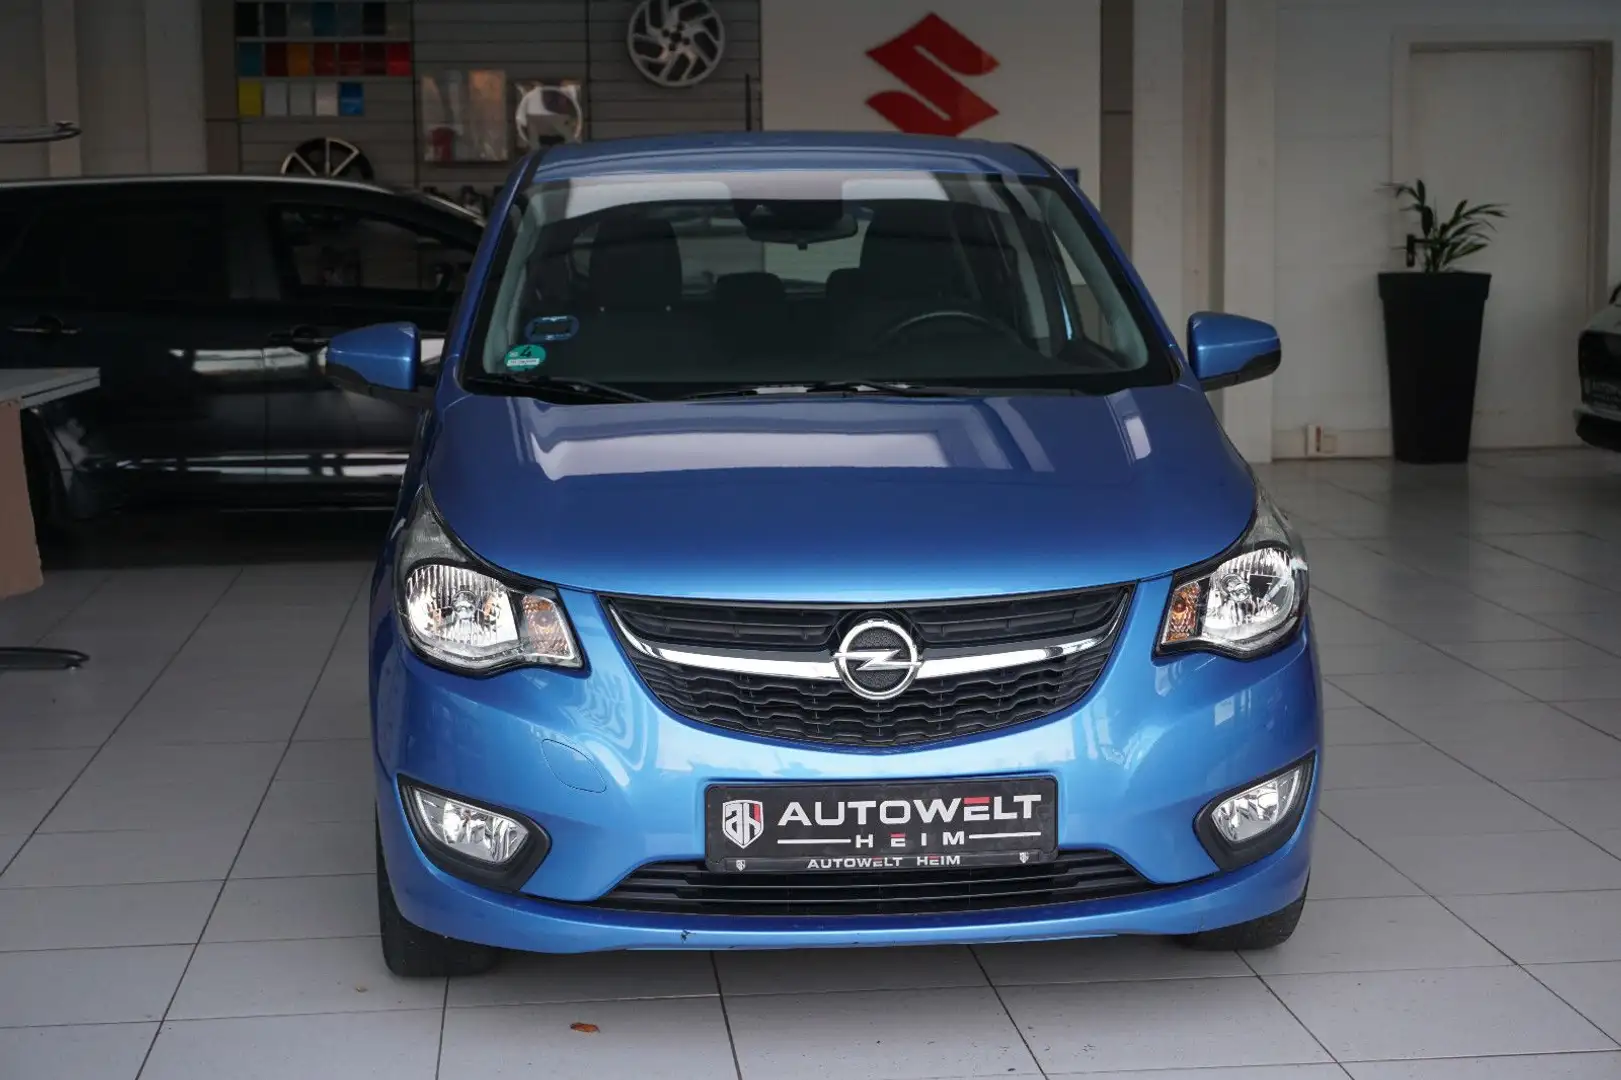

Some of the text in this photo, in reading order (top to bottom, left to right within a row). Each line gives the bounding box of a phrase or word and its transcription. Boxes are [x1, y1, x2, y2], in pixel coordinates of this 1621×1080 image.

[520, 345, 532, 357] 4
[777, 794, 1042, 826] AUTOWELT
[855, 831, 965, 848] HEIM
[807, 855, 961, 868] AUTOWELT HEIM
